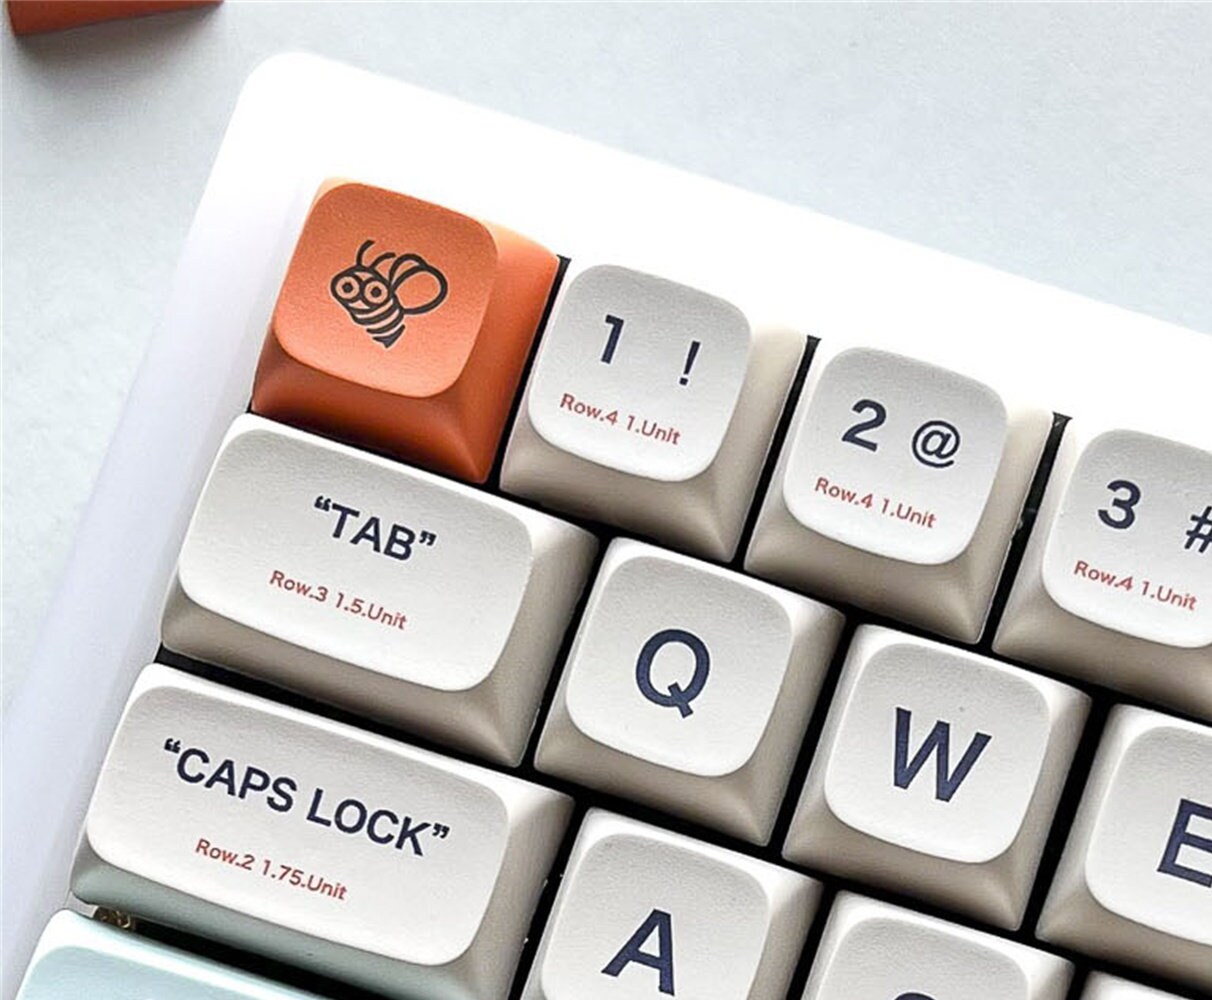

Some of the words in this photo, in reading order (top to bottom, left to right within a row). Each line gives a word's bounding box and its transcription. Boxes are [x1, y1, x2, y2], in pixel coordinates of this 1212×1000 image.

[602, 315, 624, 363] 1
[680, 341, 700, 385] !
[559, 393, 618, 425] Row.4
[628, 415, 680, 443] 1.Unit
[842, 400, 886, 451] 2
[912, 421, 960, 468] @
[816, 477, 874, 509] Row.4
[883, 499, 936, 527] 1.Unit
[1099, 480, 1140, 529] 3
[270, 571, 328, 600] Row.3
[336, 591, 407, 630] 1.5.Unit
[1075, 560, 1134, 591] Row.4
[1142, 581, 1196, 611] 1.Unit
[636, 629, 710, 718] Q
[894, 707, 991, 802] W
[195, 838, 255, 870] Row.2
[262, 860, 346, 899] 1.75.Unit
[602, 909, 674, 996] A
